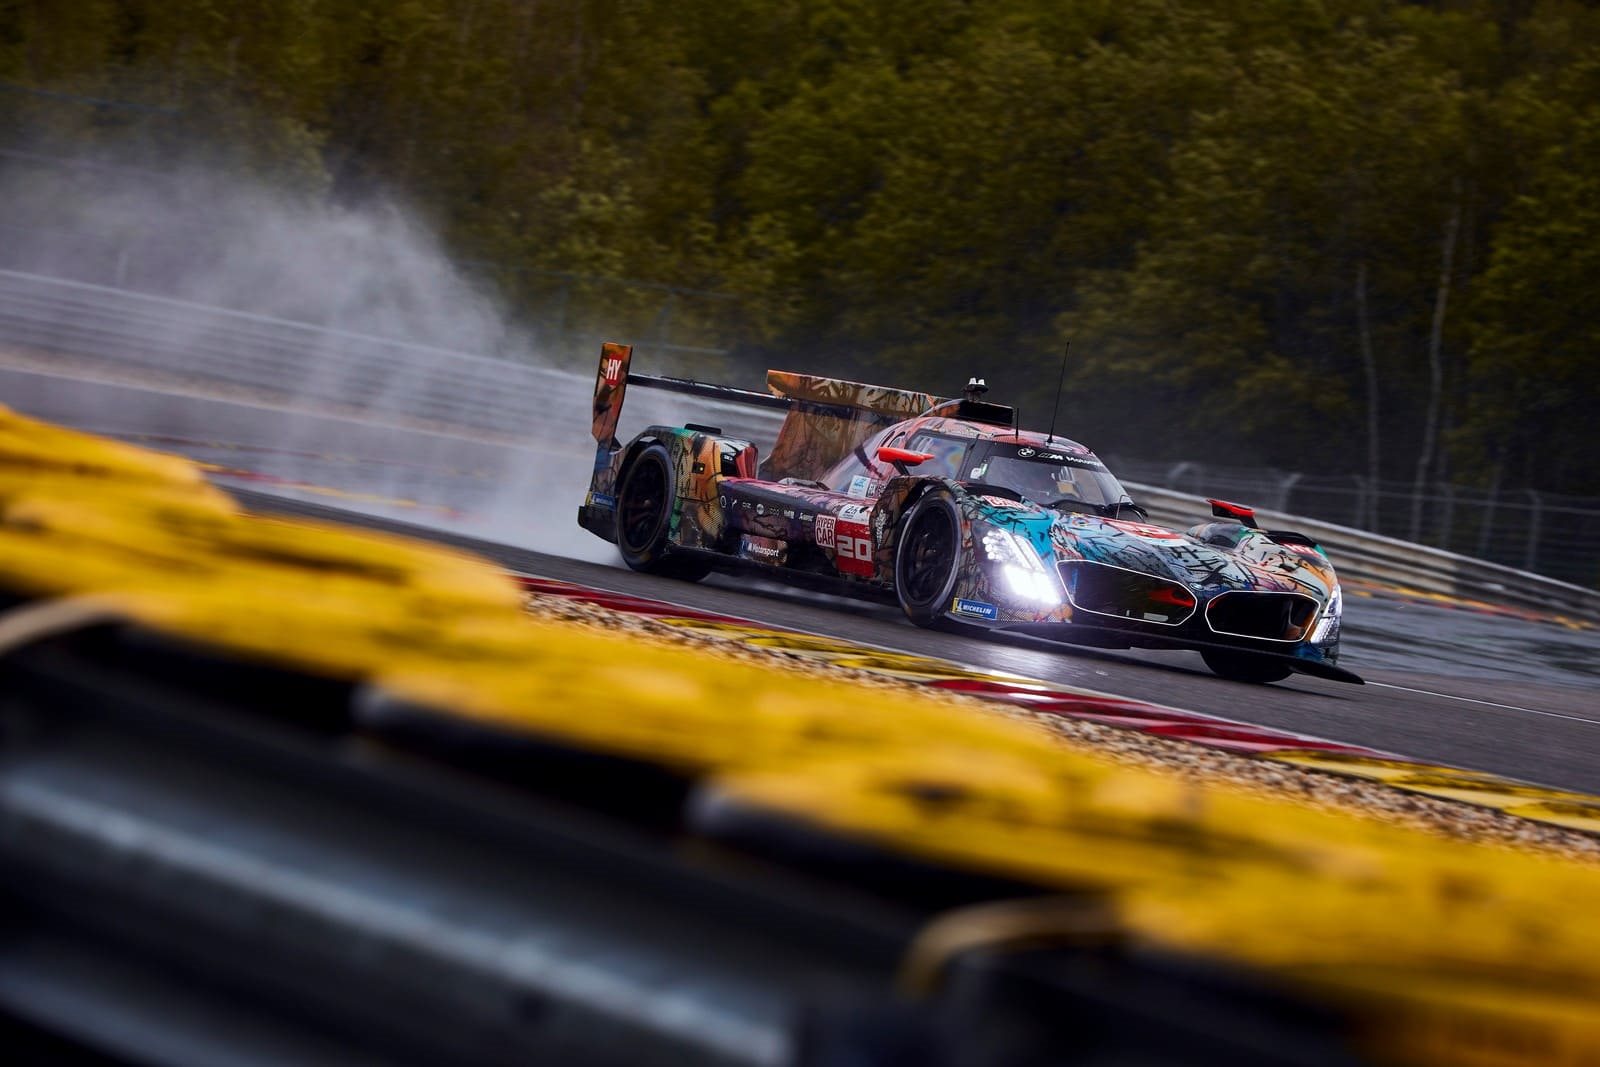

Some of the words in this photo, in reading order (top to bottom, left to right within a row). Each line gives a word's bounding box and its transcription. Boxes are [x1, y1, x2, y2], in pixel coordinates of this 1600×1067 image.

[606, 358, 622, 380] HY
[816, 517, 834, 529] HYPER
[816, 528, 834, 546] CAR
[837, 535, 872, 562] 20
[962, 604, 992, 615] MICHELIN
